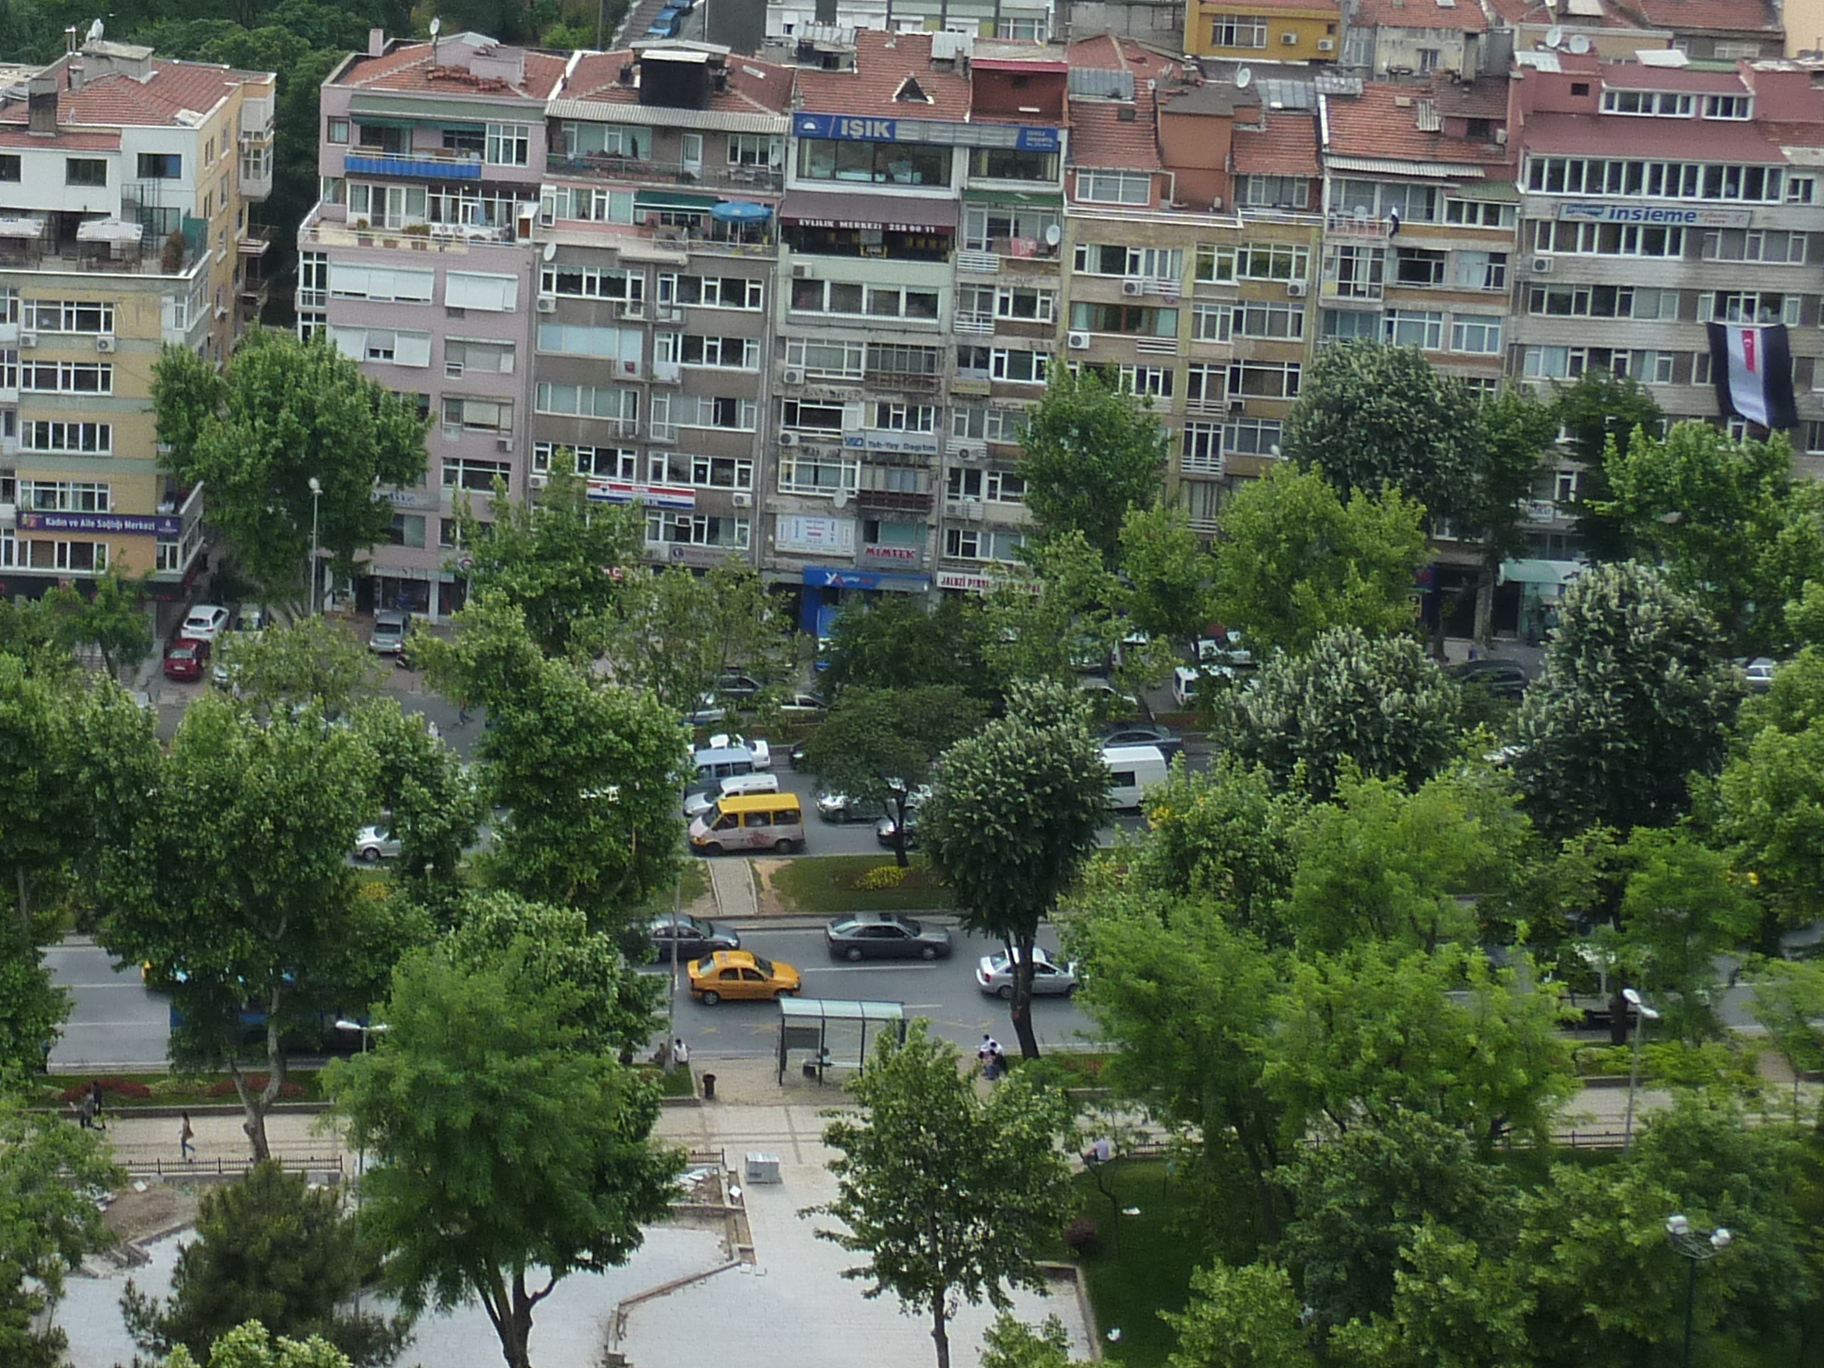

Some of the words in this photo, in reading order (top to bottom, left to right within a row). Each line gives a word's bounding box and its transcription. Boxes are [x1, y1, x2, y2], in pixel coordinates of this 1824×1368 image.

[841, 119, 890, 139] IŞIK
[1609, 206, 1696, 223] insieme
[46, 517, 68, 527] Kadın
[80, 518, 95, 528] Aile
[125, 520, 155, 531] Merkezi
